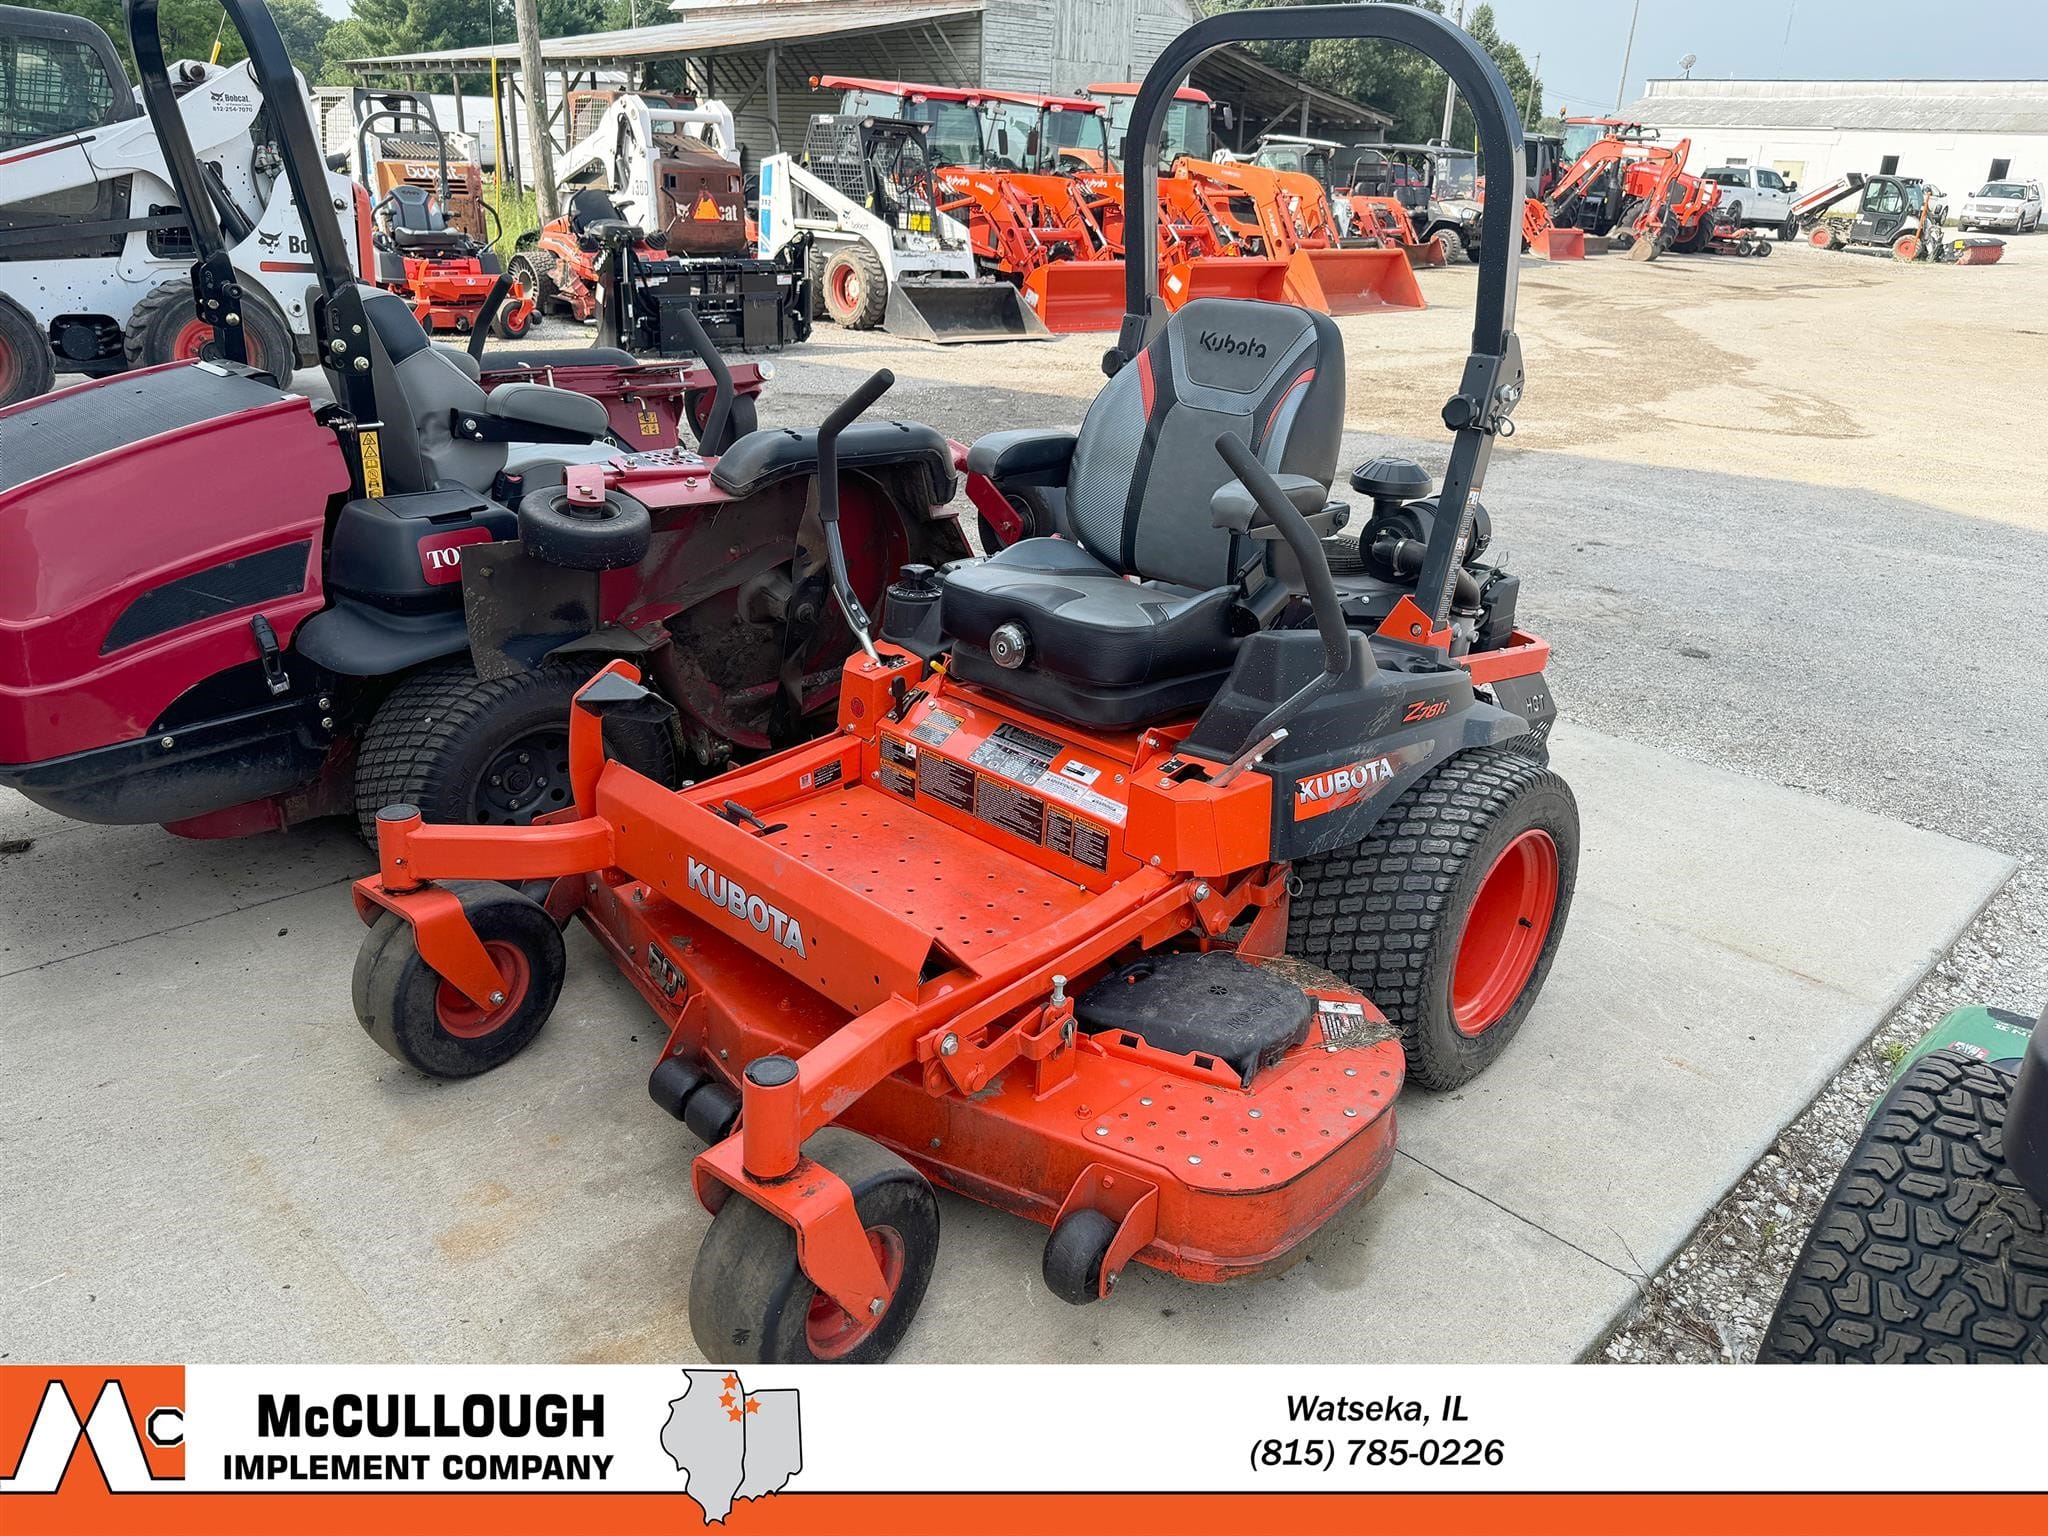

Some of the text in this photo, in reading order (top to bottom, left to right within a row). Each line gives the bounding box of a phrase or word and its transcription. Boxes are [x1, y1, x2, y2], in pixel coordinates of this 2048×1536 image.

[224, 94, 249, 102] Bobcat
[718, 204, 738, 221] cat
[1199, 330, 1267, 359] Kubota
[426, 546, 461, 569] TO
[1526, 694, 1545, 714] HOT
[1300, 757, 1395, 805] KUBOTA
[687, 855, 807, 960] KUBOTA
